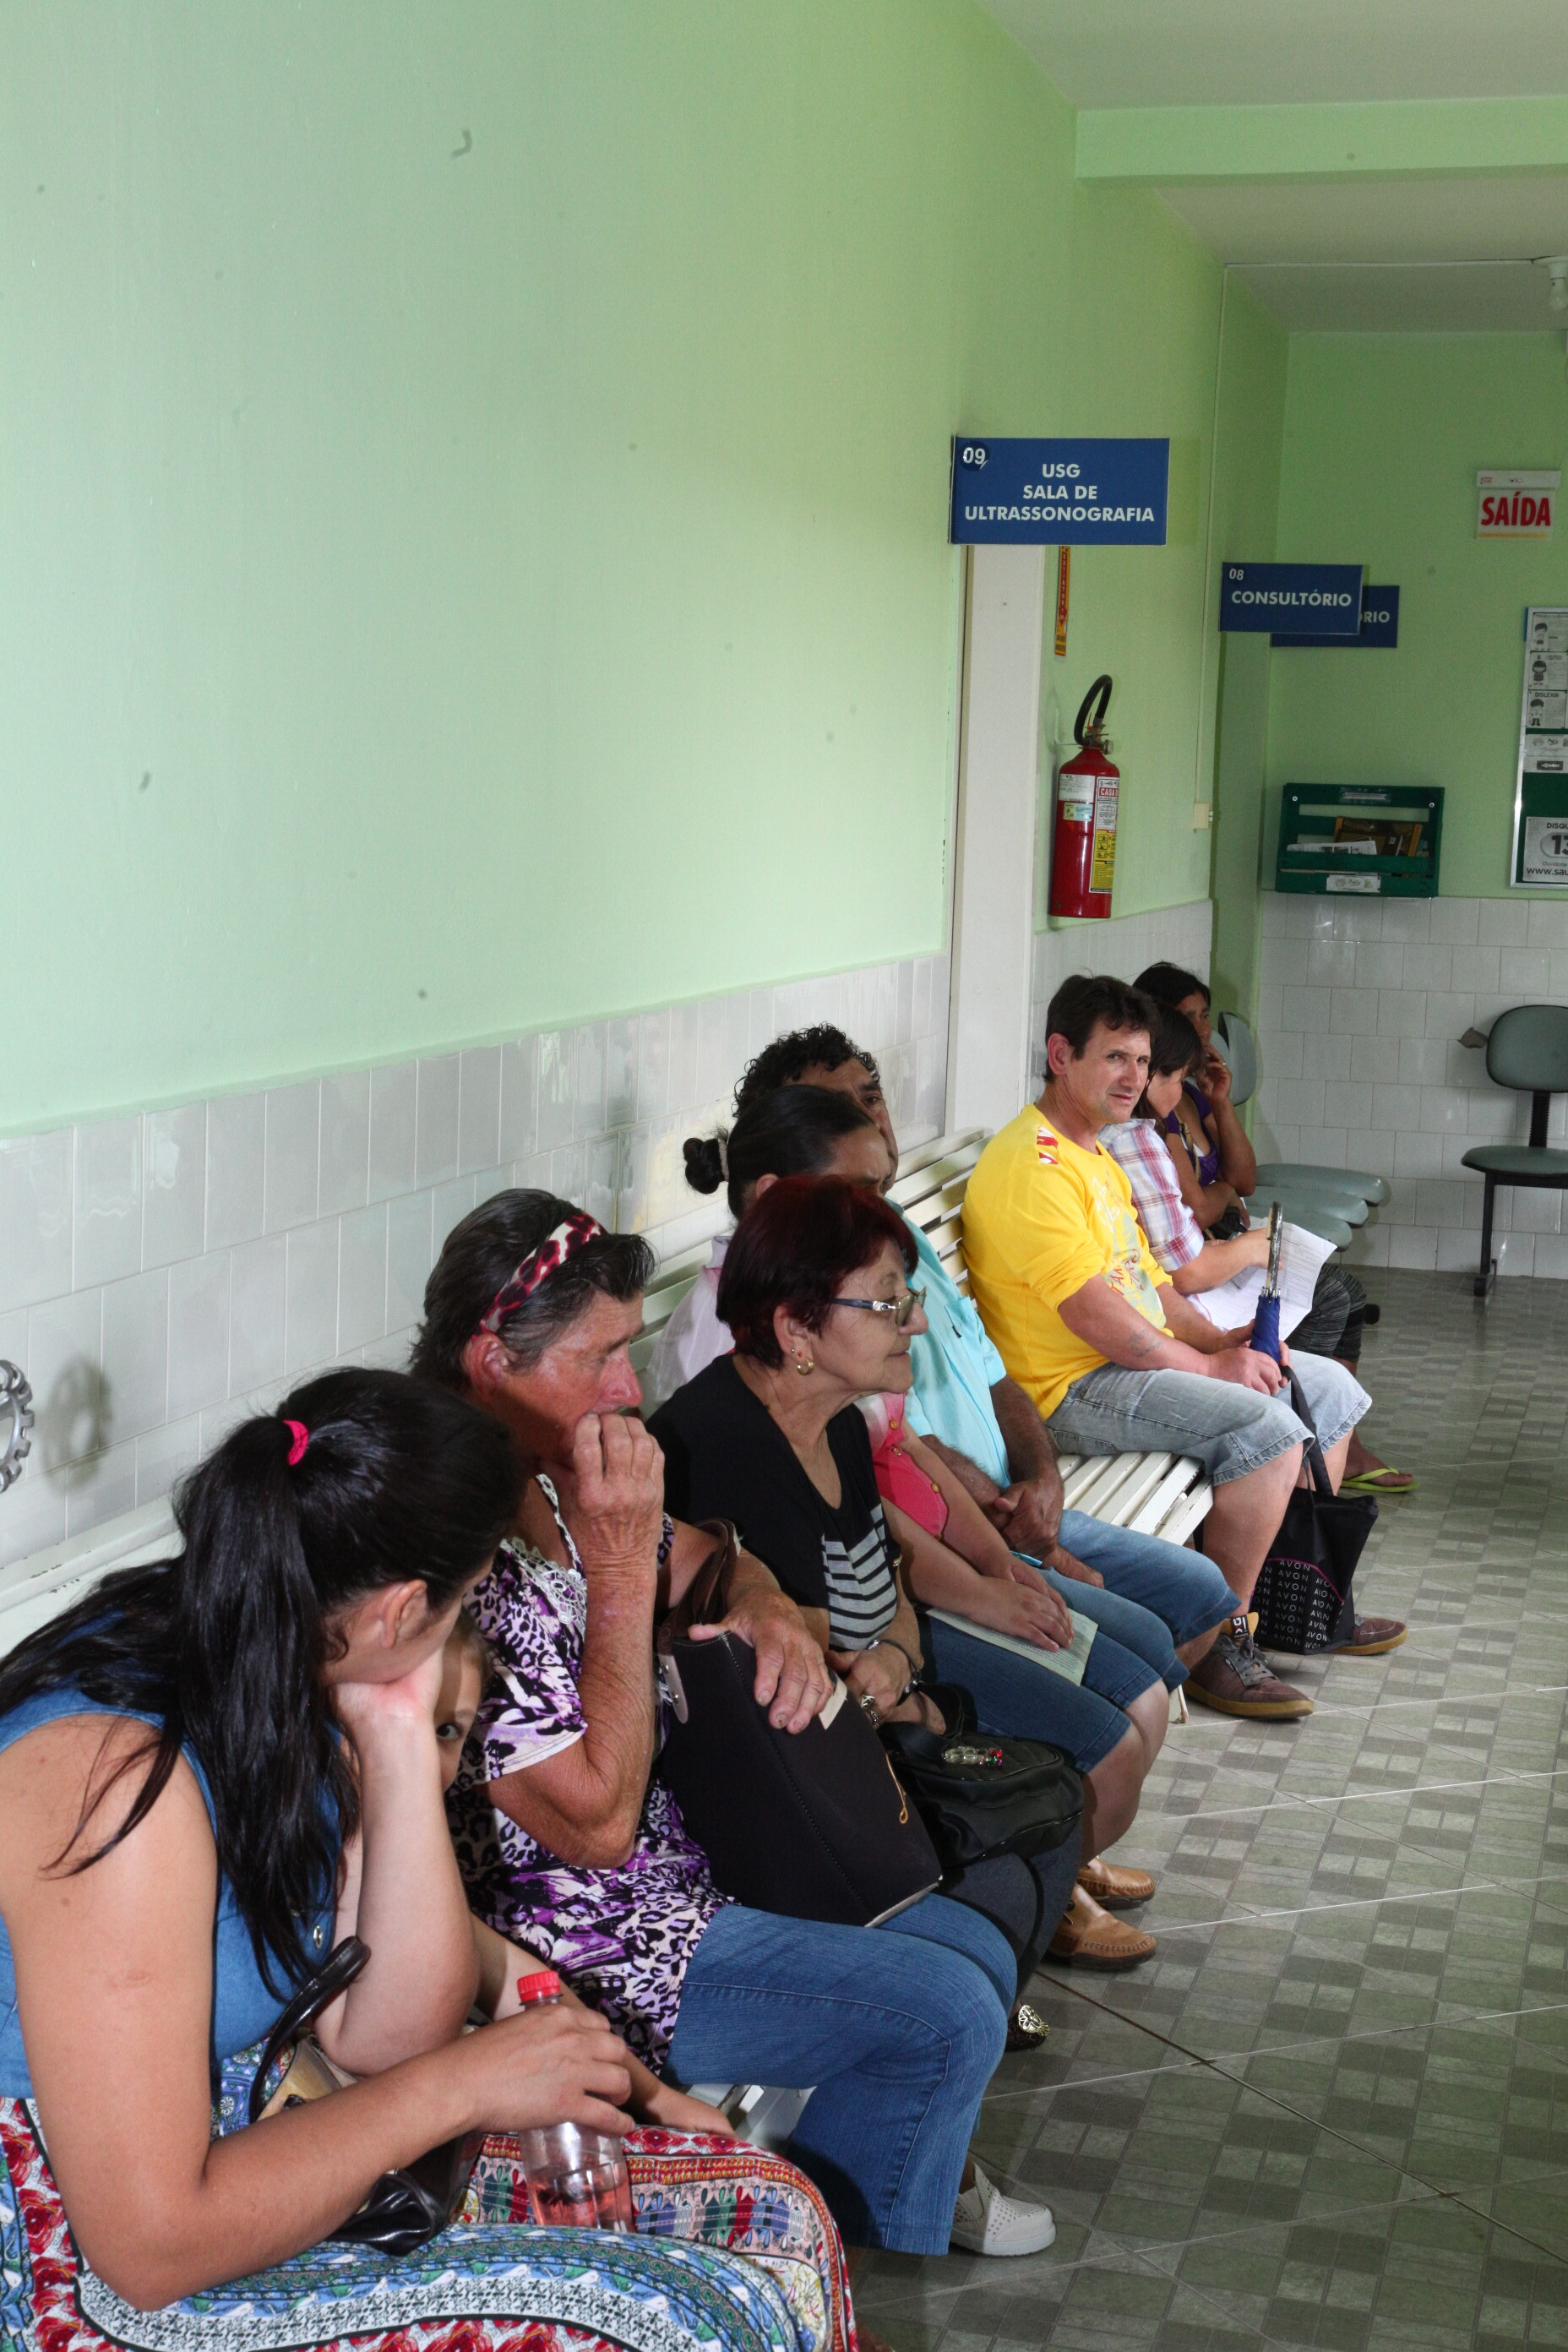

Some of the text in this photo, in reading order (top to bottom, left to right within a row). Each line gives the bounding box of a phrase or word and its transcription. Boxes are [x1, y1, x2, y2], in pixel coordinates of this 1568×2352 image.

[962, 447, 987, 465] 09
[1042, 464, 1081, 478] USG
[1023, 484, 1097, 499] SALA DE
[965, 505, 1155, 522] ULTRASSONOGRAFIA
[1481, 491, 1551, 526] SAÍDA
[1228, 569, 1244, 580] 08
[1231, 590, 1352, 607] CONSULTÓRIO
[1101, 787, 1115, 796] CASA
[1279, 1560, 1309, 1571] AVON
[1278, 1570, 1309, 1582] AVON
[1277, 1581, 1307, 1592] AVON
[1277, 1591, 1305, 1603] AVON
[1276, 1602, 1304, 1614] AVON
[1306, 1631, 1327, 1642] AVON
